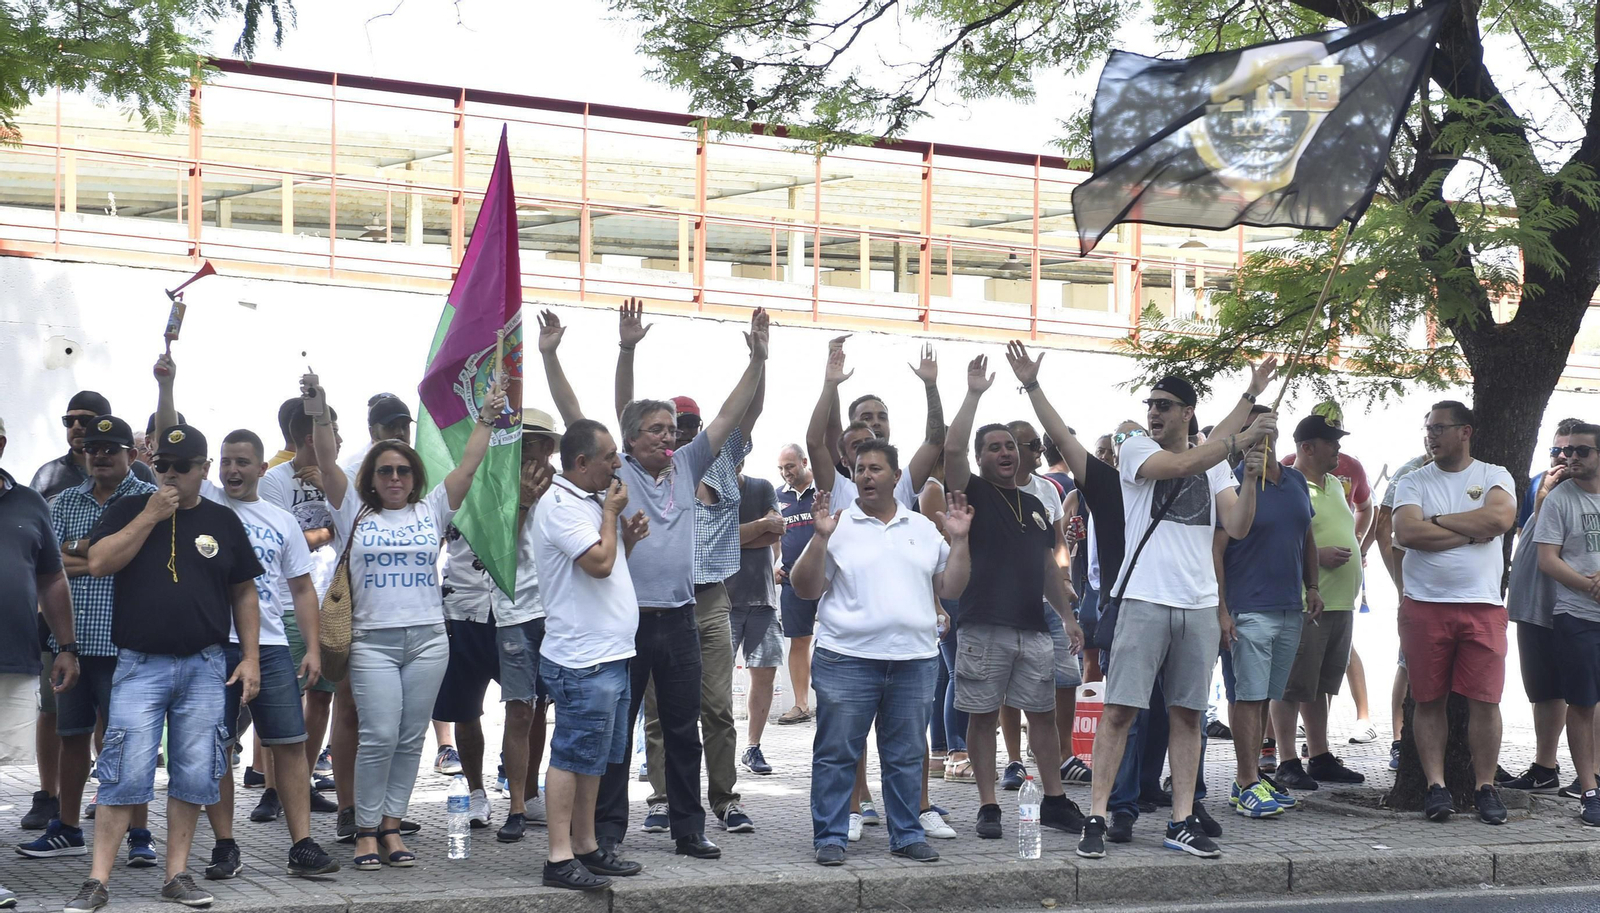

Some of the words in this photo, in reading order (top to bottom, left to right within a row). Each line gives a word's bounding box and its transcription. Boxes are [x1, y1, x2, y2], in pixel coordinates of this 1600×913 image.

[784, 514, 800, 525] PEN
[800, 512, 813, 521] WA
[363, 552, 408, 568] POR
[414, 551, 438, 566] SU
